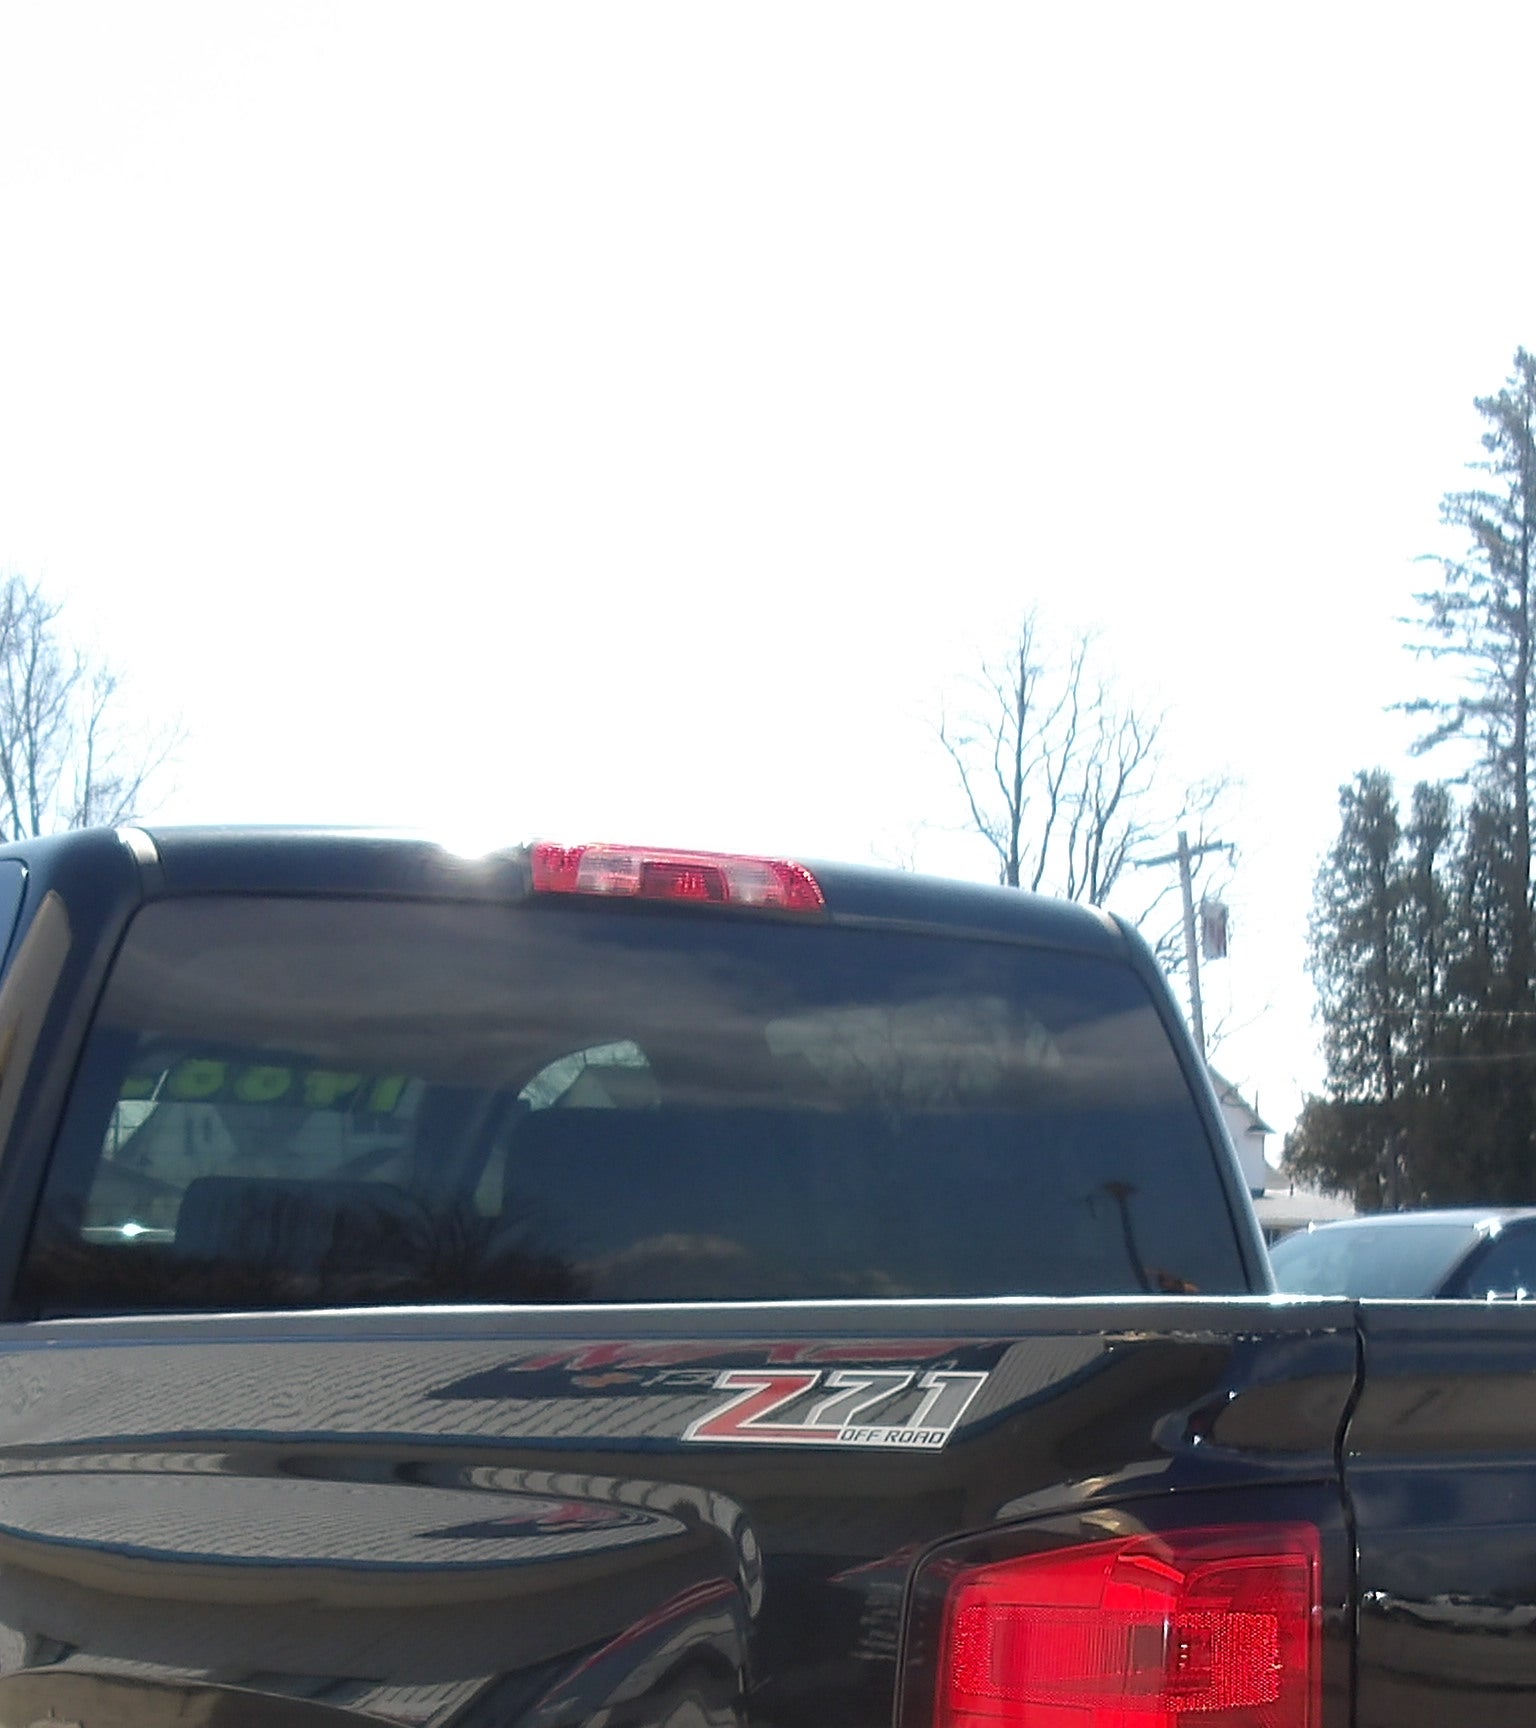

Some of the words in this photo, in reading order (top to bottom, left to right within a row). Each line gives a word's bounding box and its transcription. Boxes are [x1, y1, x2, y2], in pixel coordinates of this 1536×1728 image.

[680, 1369, 990, 1443] Z71
[840, 1428, 880, 1442] OFF
[883, 1429, 946, 1444] ROAD
